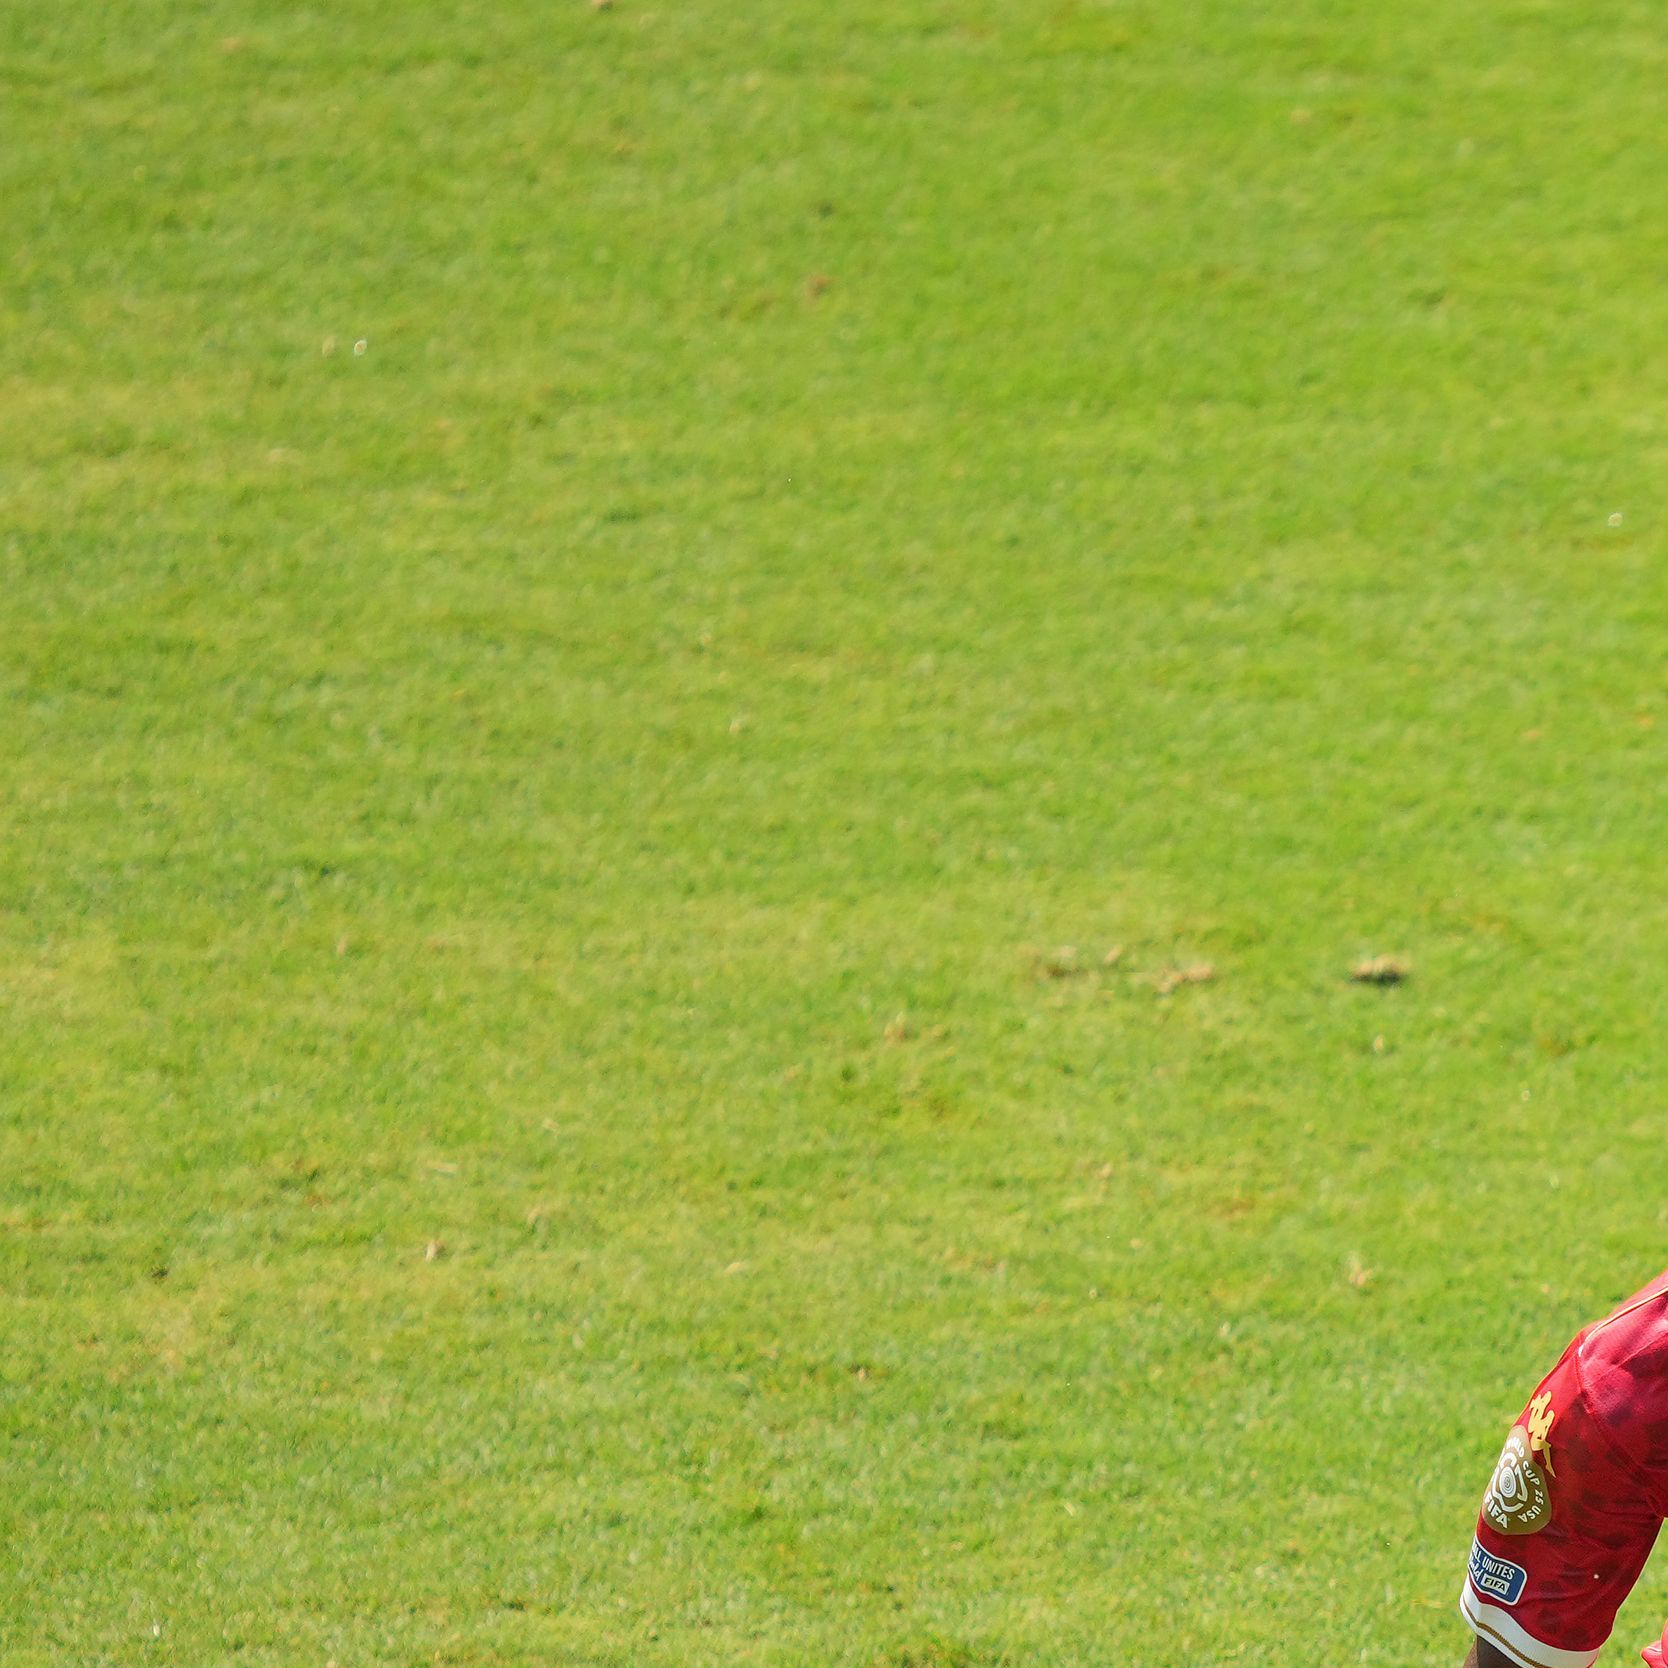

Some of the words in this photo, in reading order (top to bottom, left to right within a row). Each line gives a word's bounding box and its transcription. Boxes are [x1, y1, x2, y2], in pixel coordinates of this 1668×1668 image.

[1522, 1461, 1541, 1486] CUP
[1535, 1489, 1544, 1505] 25
[1484, 1491, 1508, 1528] FIFA
[1517, 1505, 1541, 1522] USA
[1482, 1556, 1516, 1580] UNITES
[1484, 1578, 1506, 1592] FIFA
